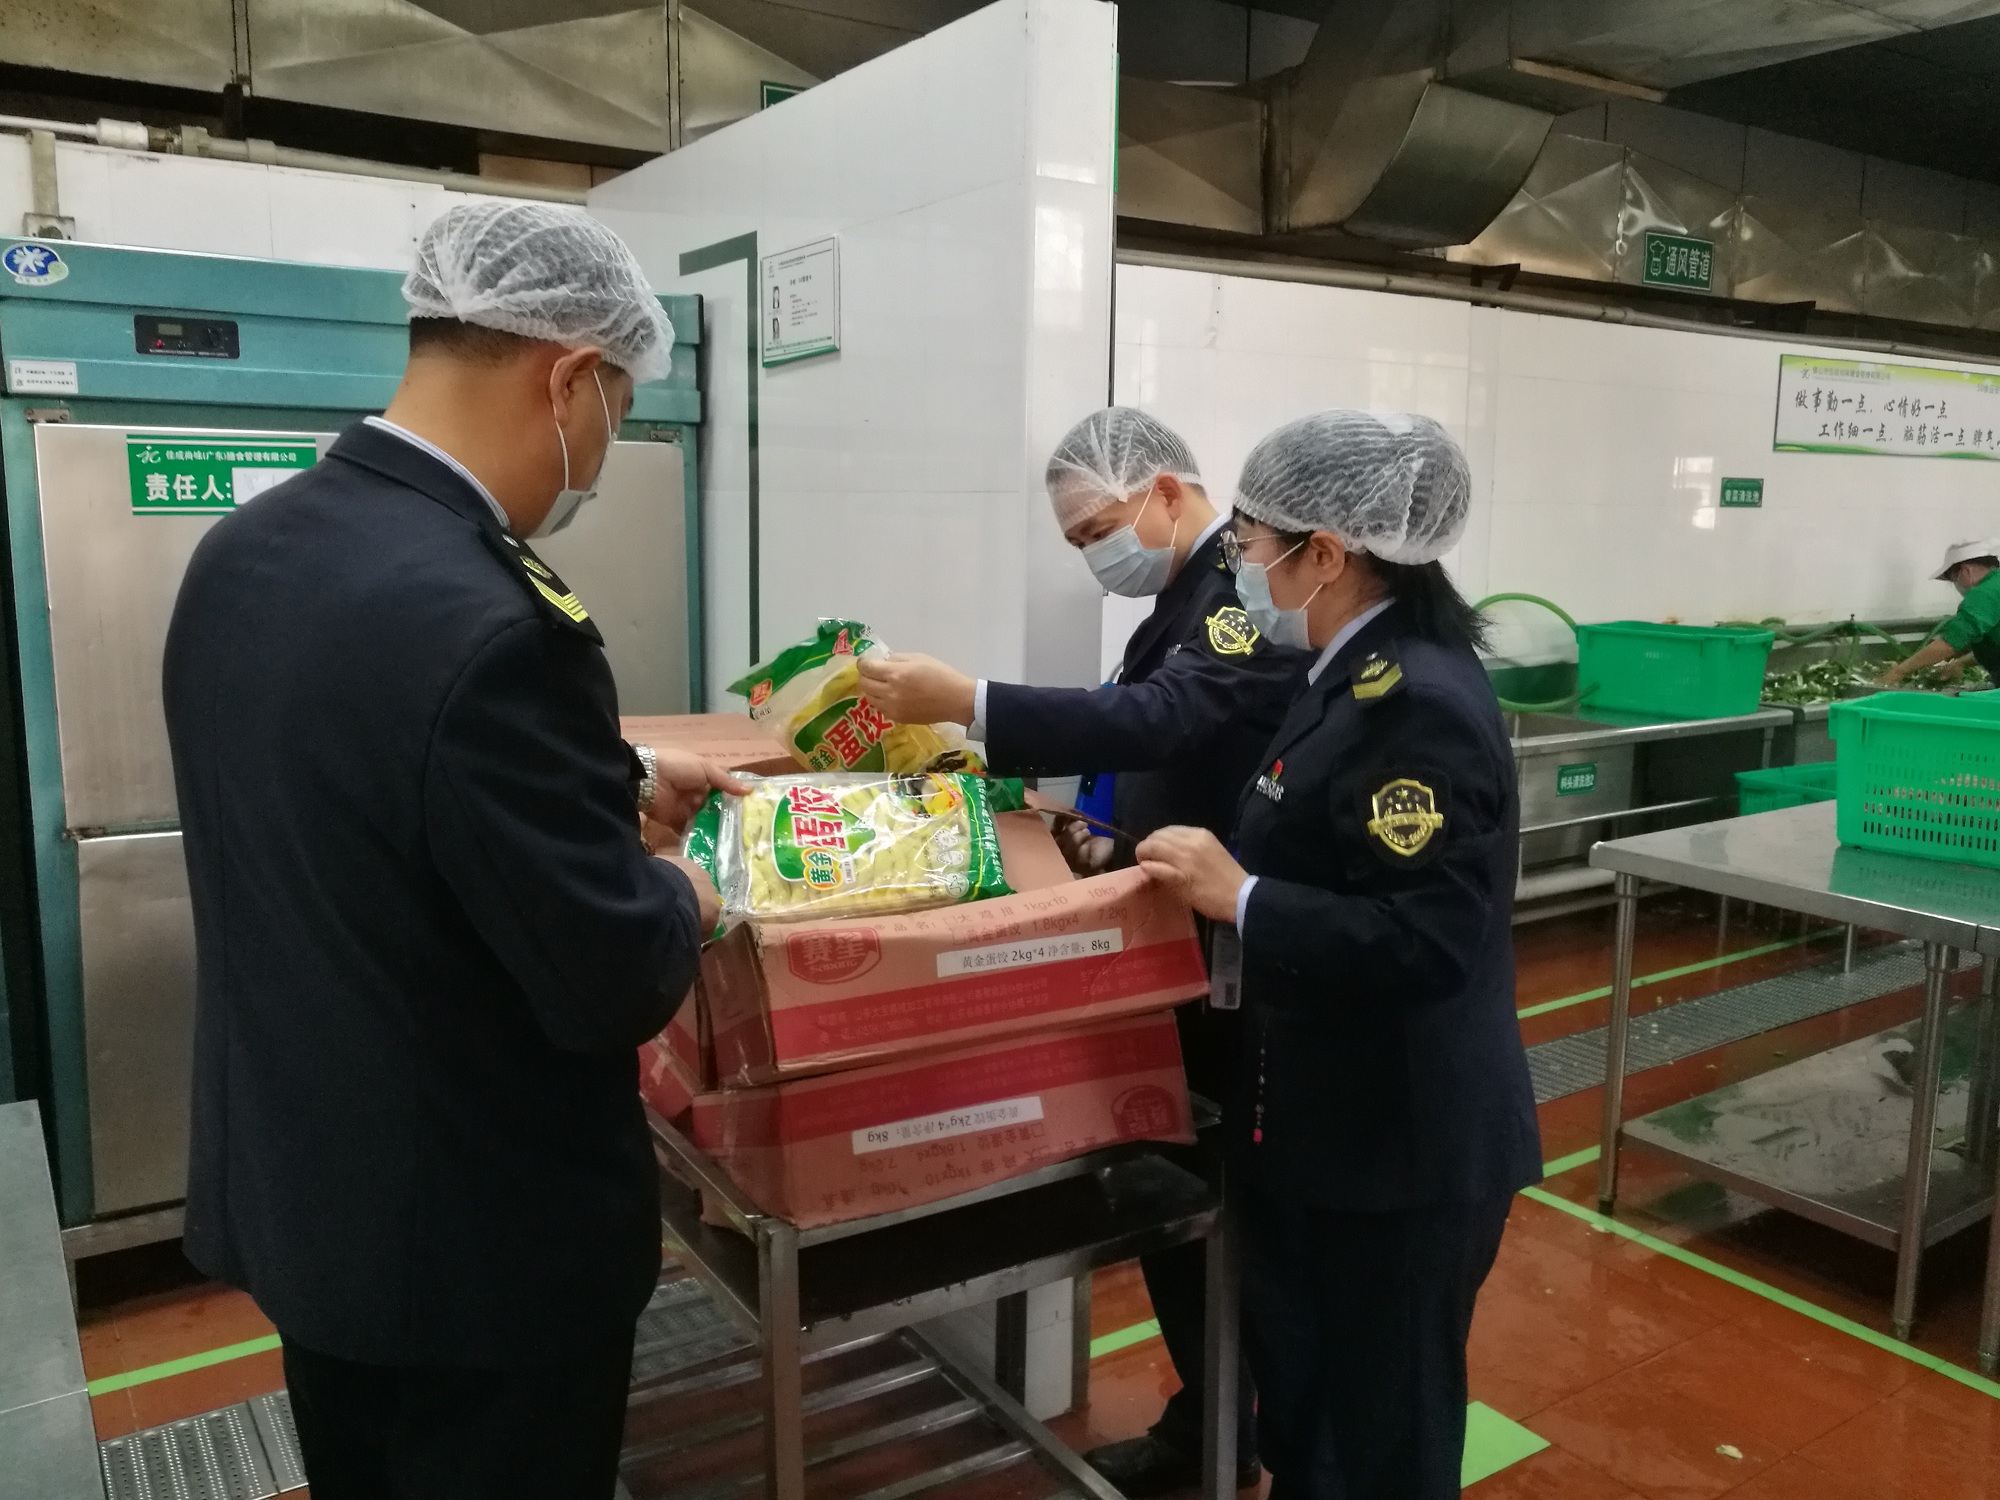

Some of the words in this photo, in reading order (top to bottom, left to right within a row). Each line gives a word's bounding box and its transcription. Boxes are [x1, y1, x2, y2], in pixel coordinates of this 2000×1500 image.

[1666, 246, 1710, 280] 通风管道
[824, 696, 893, 767] 蛋饺
[788, 786, 847, 849] 蛋饺
[808, 852, 836, 883] 黄金
[1024, 896, 1068, 911] 1kgx10
[1088, 886, 1118, 899] 10kg
[1033, 913, 1080, 931] 1.8kgx4
[1098, 906, 1128, 921] 7.2kg
[962, 952, 1008, 968] 黄金蛋饺
[1091, 940, 1110, 951] 8kg
[867, 1131, 889, 1142] 8kg
